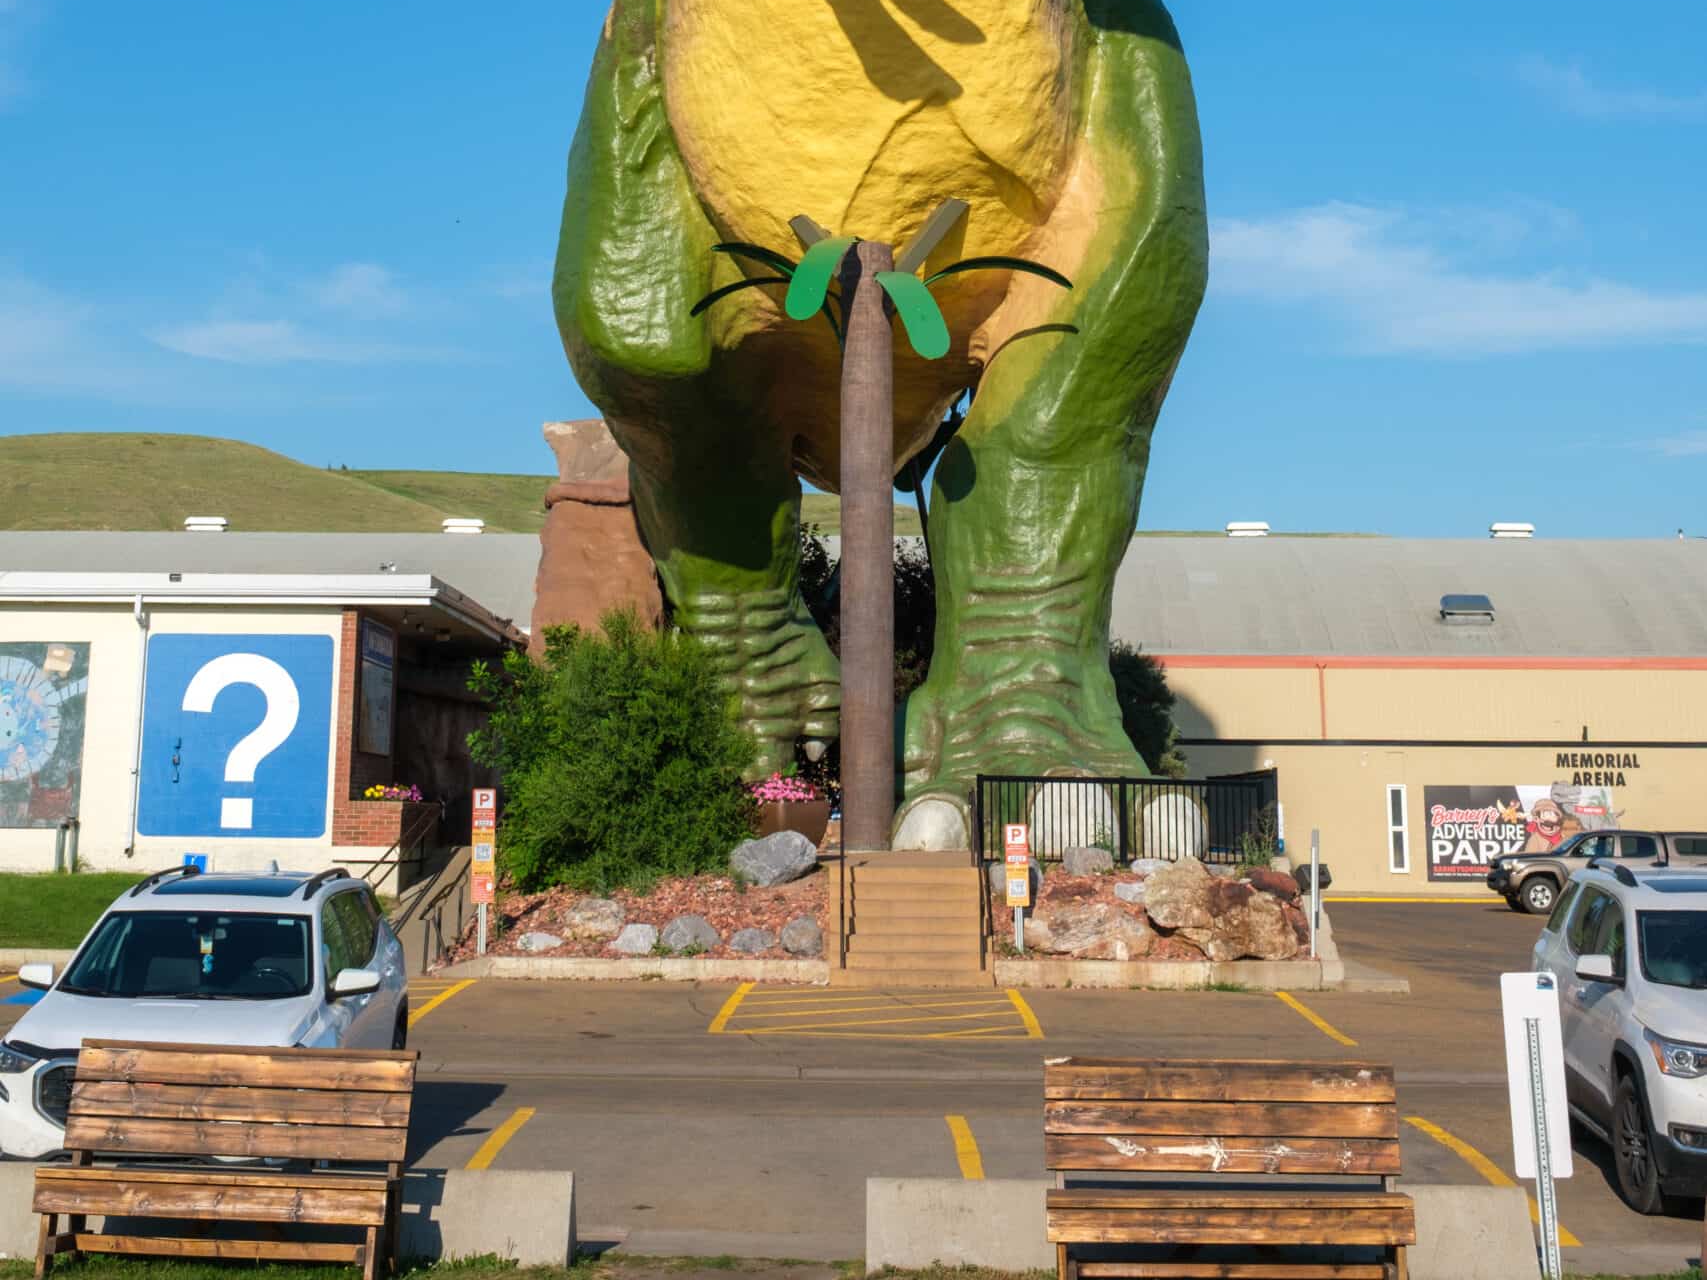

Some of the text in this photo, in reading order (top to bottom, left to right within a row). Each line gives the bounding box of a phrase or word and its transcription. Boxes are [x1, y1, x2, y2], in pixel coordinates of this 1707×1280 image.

[182, 653, 300, 829] ?
[1556, 753, 1640, 768] MEMORIAL
[1572, 771, 1626, 786] ARENA
[480, 793, 490, 806] P
[1431, 804, 1500, 830] Barney's
[1011, 828, 1022, 841] P
[1432, 823, 1525, 840] ADVENTURE
[1432, 840, 1525, 865] PARK
